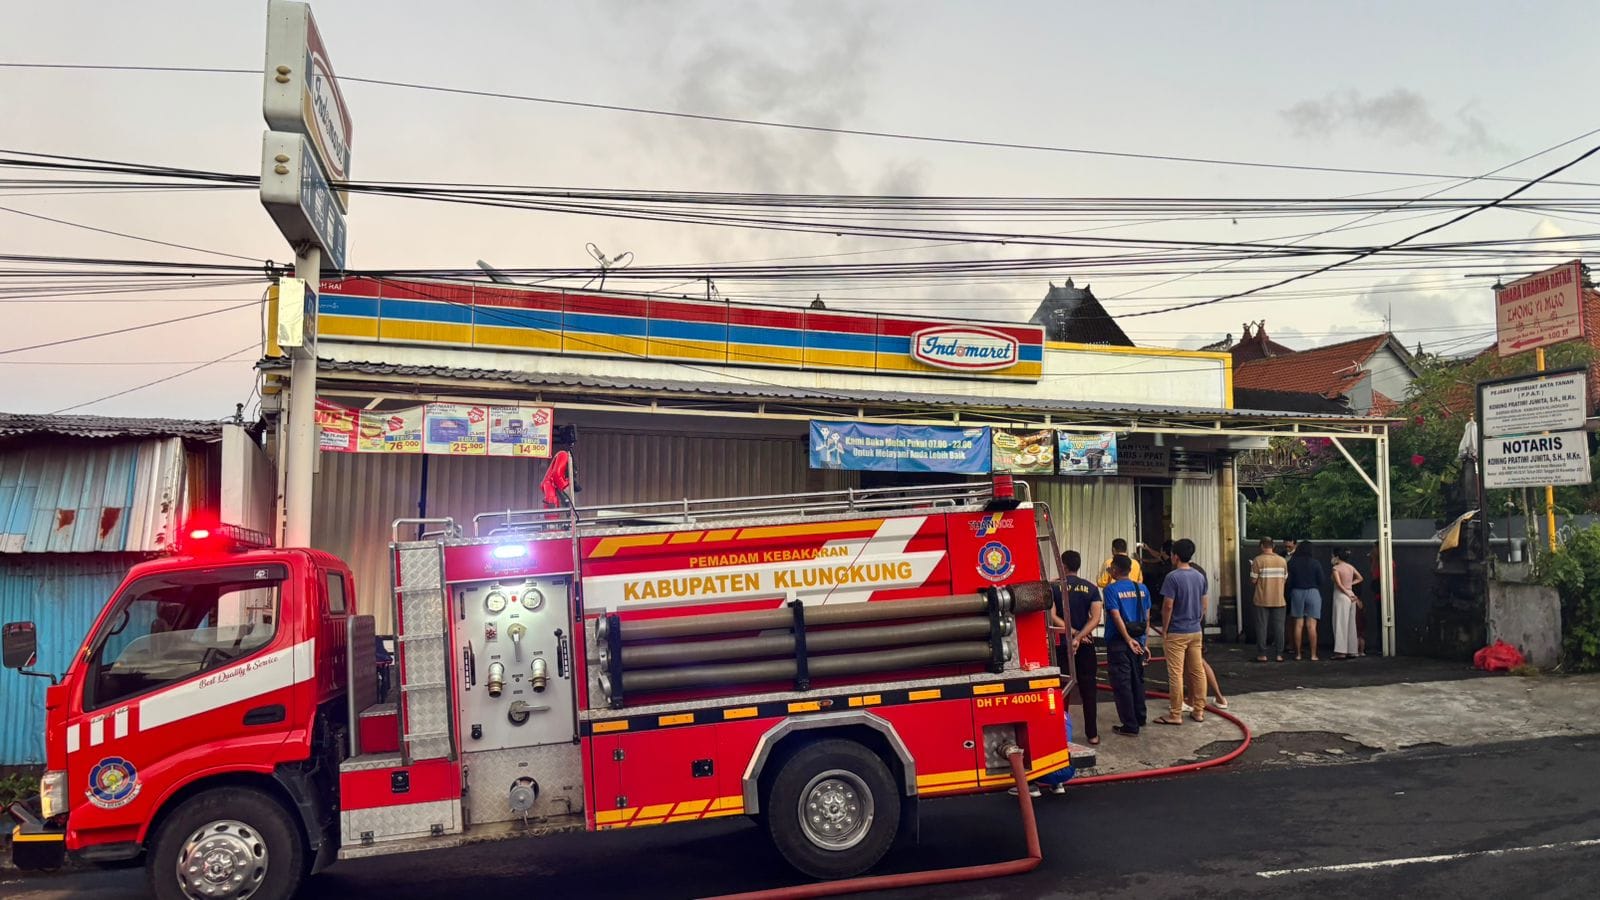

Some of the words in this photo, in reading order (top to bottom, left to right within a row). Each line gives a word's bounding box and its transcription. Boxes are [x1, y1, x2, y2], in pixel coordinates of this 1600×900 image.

[1522, 274, 1550, 298] DHARMA
[1550, 267, 1572, 289] RATNA
[1507, 301, 1533, 321] ZHONG
[1562, 328, 1569, 337] M
[922, 336, 1011, 359] Indomaret
[845, 437, 865, 446] Kami
[865, 437, 884, 446] Buka
[885, 437, 905, 447] Mulai
[906, 438, 927, 448] Pukul
[1502, 437, 1563, 455] NOTARIS
[852, 448, 875, 458] Untuk
[875, 449, 909, 460] Melayani
[910, 449, 928, 458] Anda
[929, 450, 948, 459] Lebih
[949, 450, 967, 460] Baik
[689, 552, 759, 568] PEMADAM
[764, 546, 849, 562] KEBAKARAN
[624, 572, 760, 600] KABUPATEN
[774, 561, 913, 589] KLUNGKUNG
[1118, 591, 1146, 599] DAMKR
[199, 677, 216, 690] Best
[217, 667, 246, 684] Quality
[246, 664, 252, 672] &
[252, 657, 278, 671] Service
[976, 698, 992, 708] DH
[995, 696, 1009, 706] FT
[1011, 693, 1045, 705] 4000L
